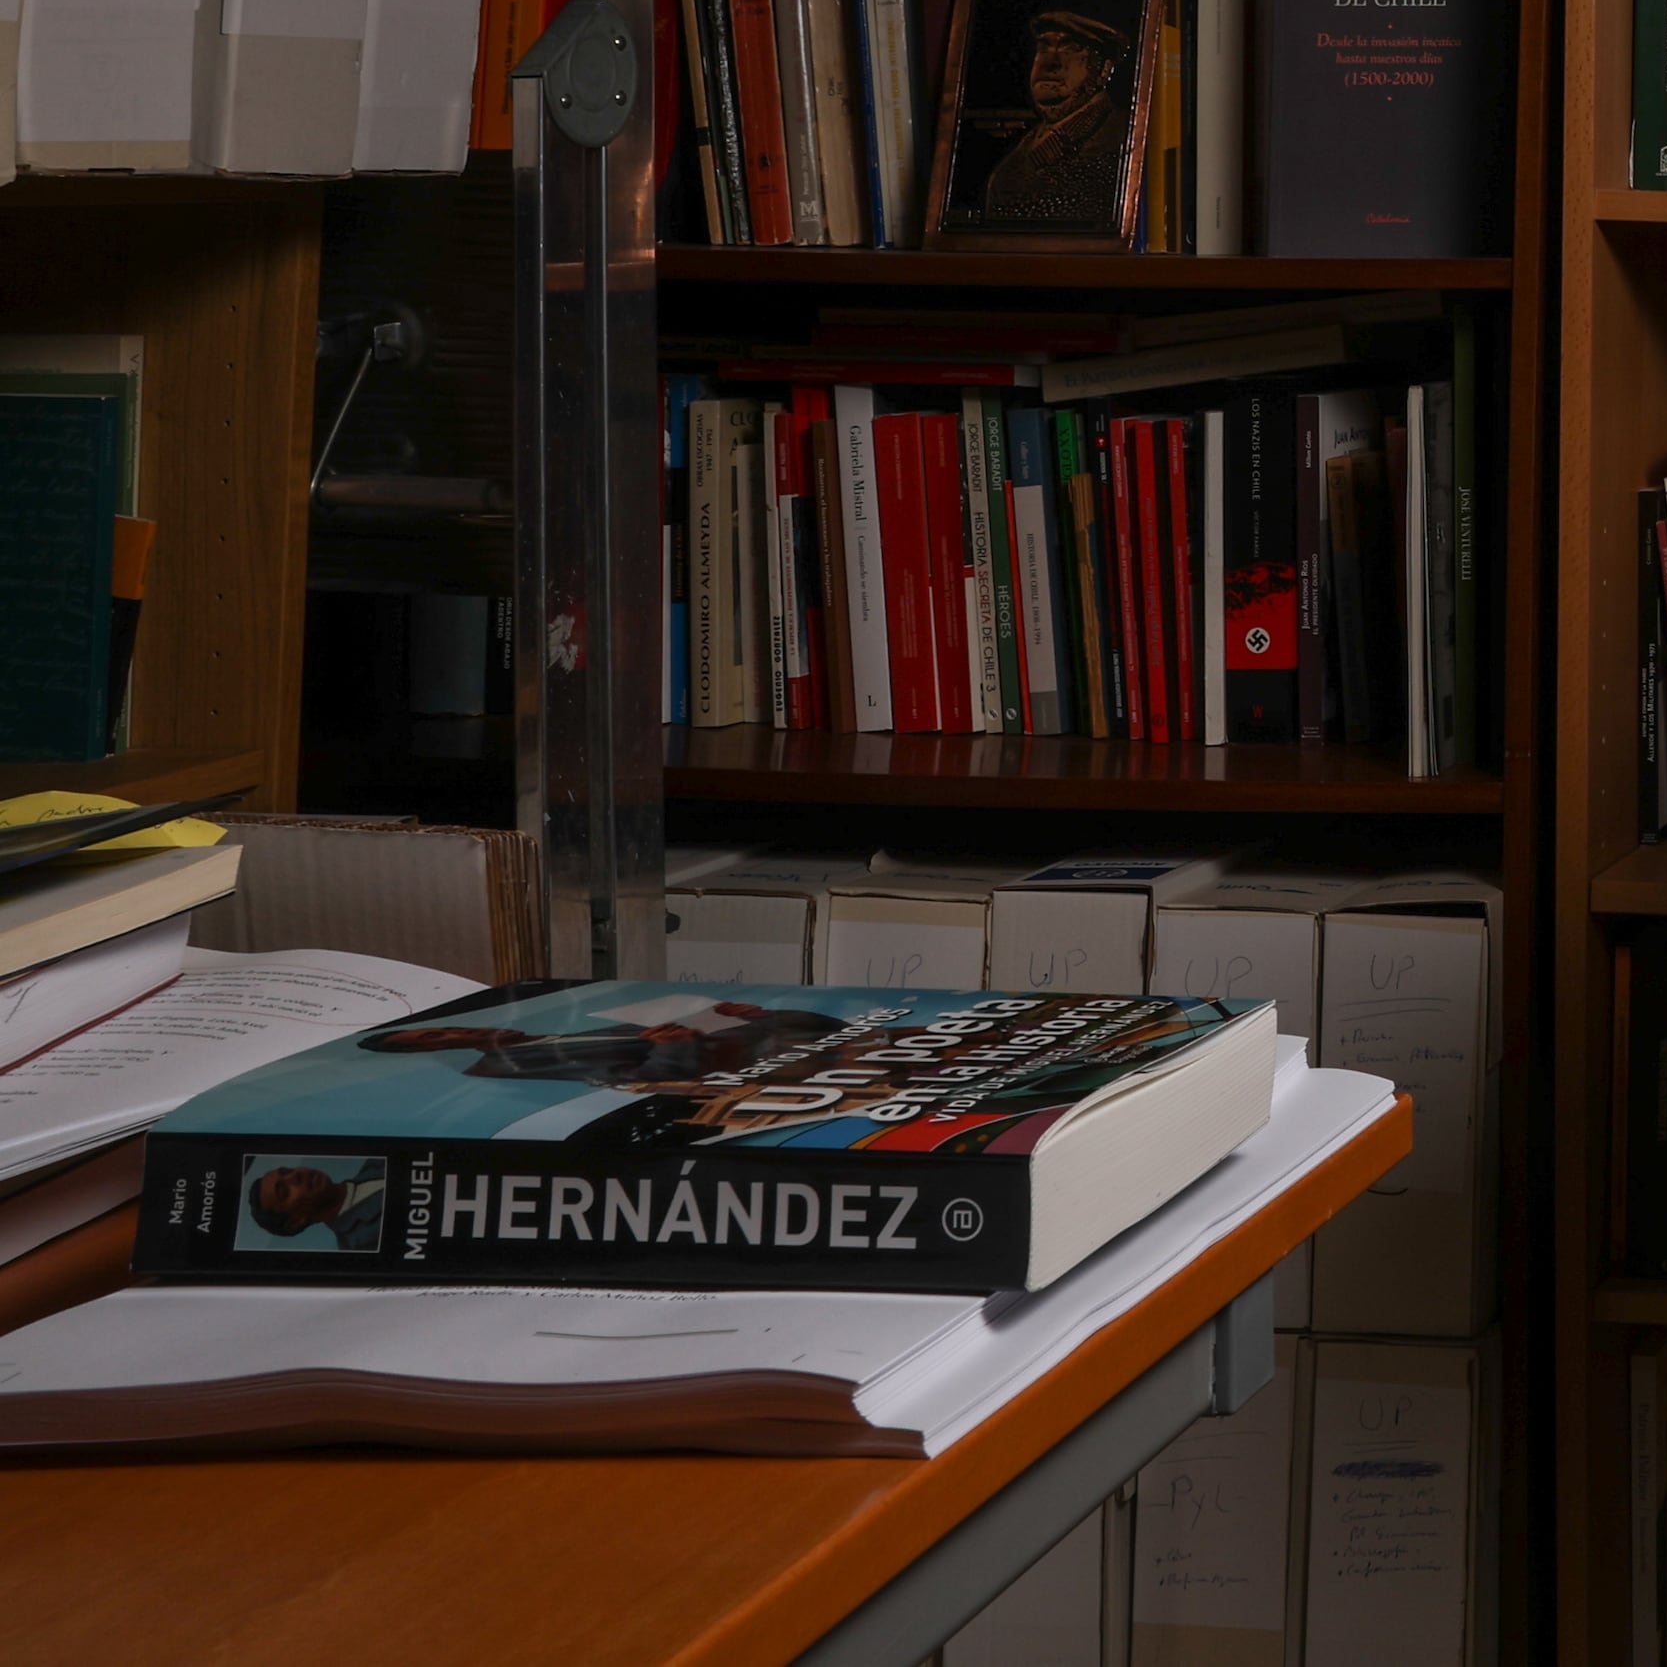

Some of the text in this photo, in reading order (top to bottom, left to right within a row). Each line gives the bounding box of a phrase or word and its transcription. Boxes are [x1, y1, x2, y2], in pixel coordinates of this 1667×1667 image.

[1344, 71, 1434, 86] (1500-2000)
[849, 425, 867, 521] Gabriela Mistral
[700, 503, 710, 713] CLODOMIRO ALMEYDA
[703, 1005, 913, 1087] Mario Amorós
[733, 996, 1046, 1114] Un poeta
[869, 999, 1135, 1123] en la Historia
[928, 1091, 990, 1123] VIDA
[983, 1077, 1017, 1090] DE
[1005, 1041, 1083, 1075] MIGUEL
[169, 1170, 218, 1234] Mario Amorós
[403, 1151, 920, 1260] MIGUEL HERNÁNDEZ
